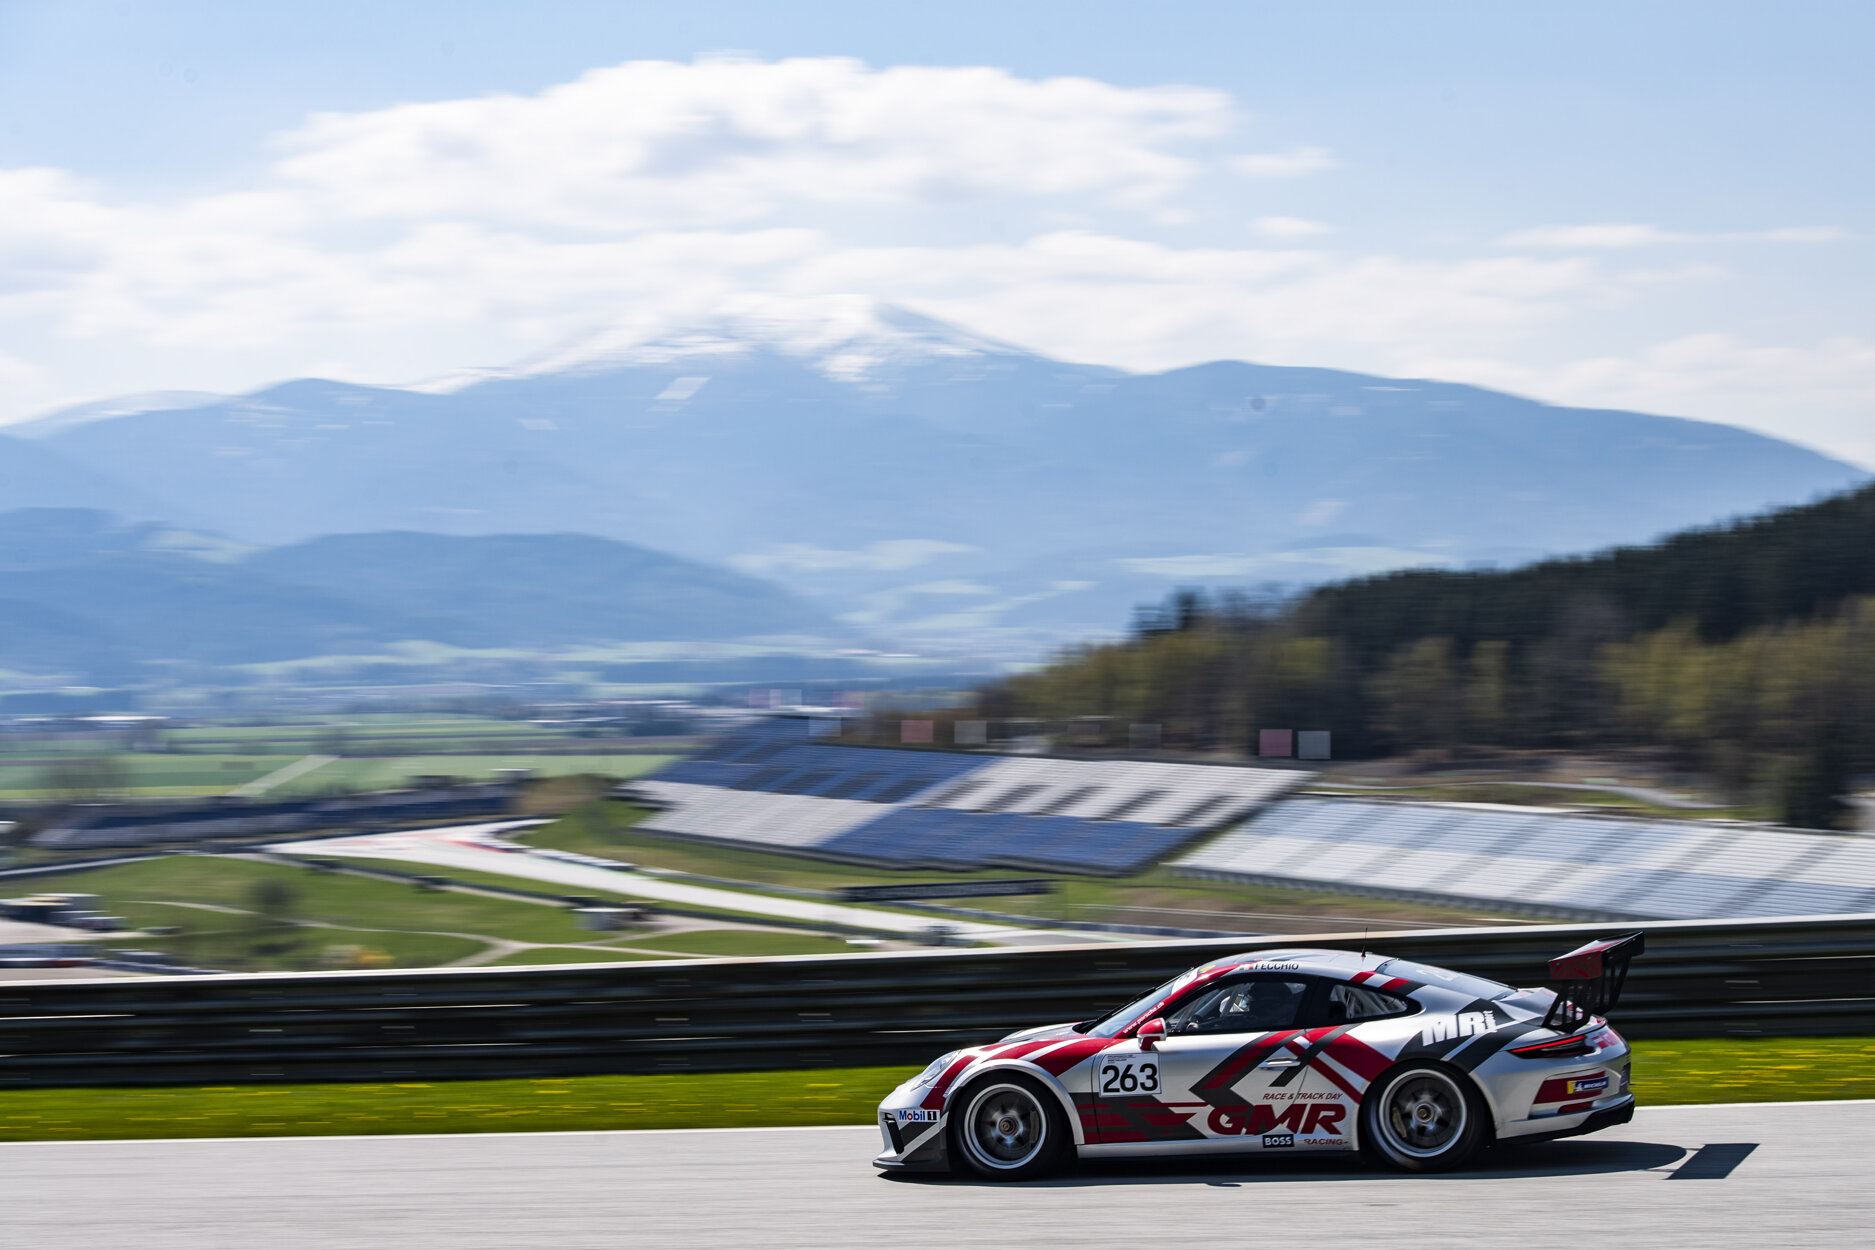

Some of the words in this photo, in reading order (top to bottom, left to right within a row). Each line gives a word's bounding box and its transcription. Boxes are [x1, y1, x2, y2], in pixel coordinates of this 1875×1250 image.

[1102, 1063, 1158, 1093] 263
[899, 1110, 926, 1121] Mobil
[1207, 1103, 1347, 1136] GMR
[1264, 1136, 1292, 1146] BOSS
